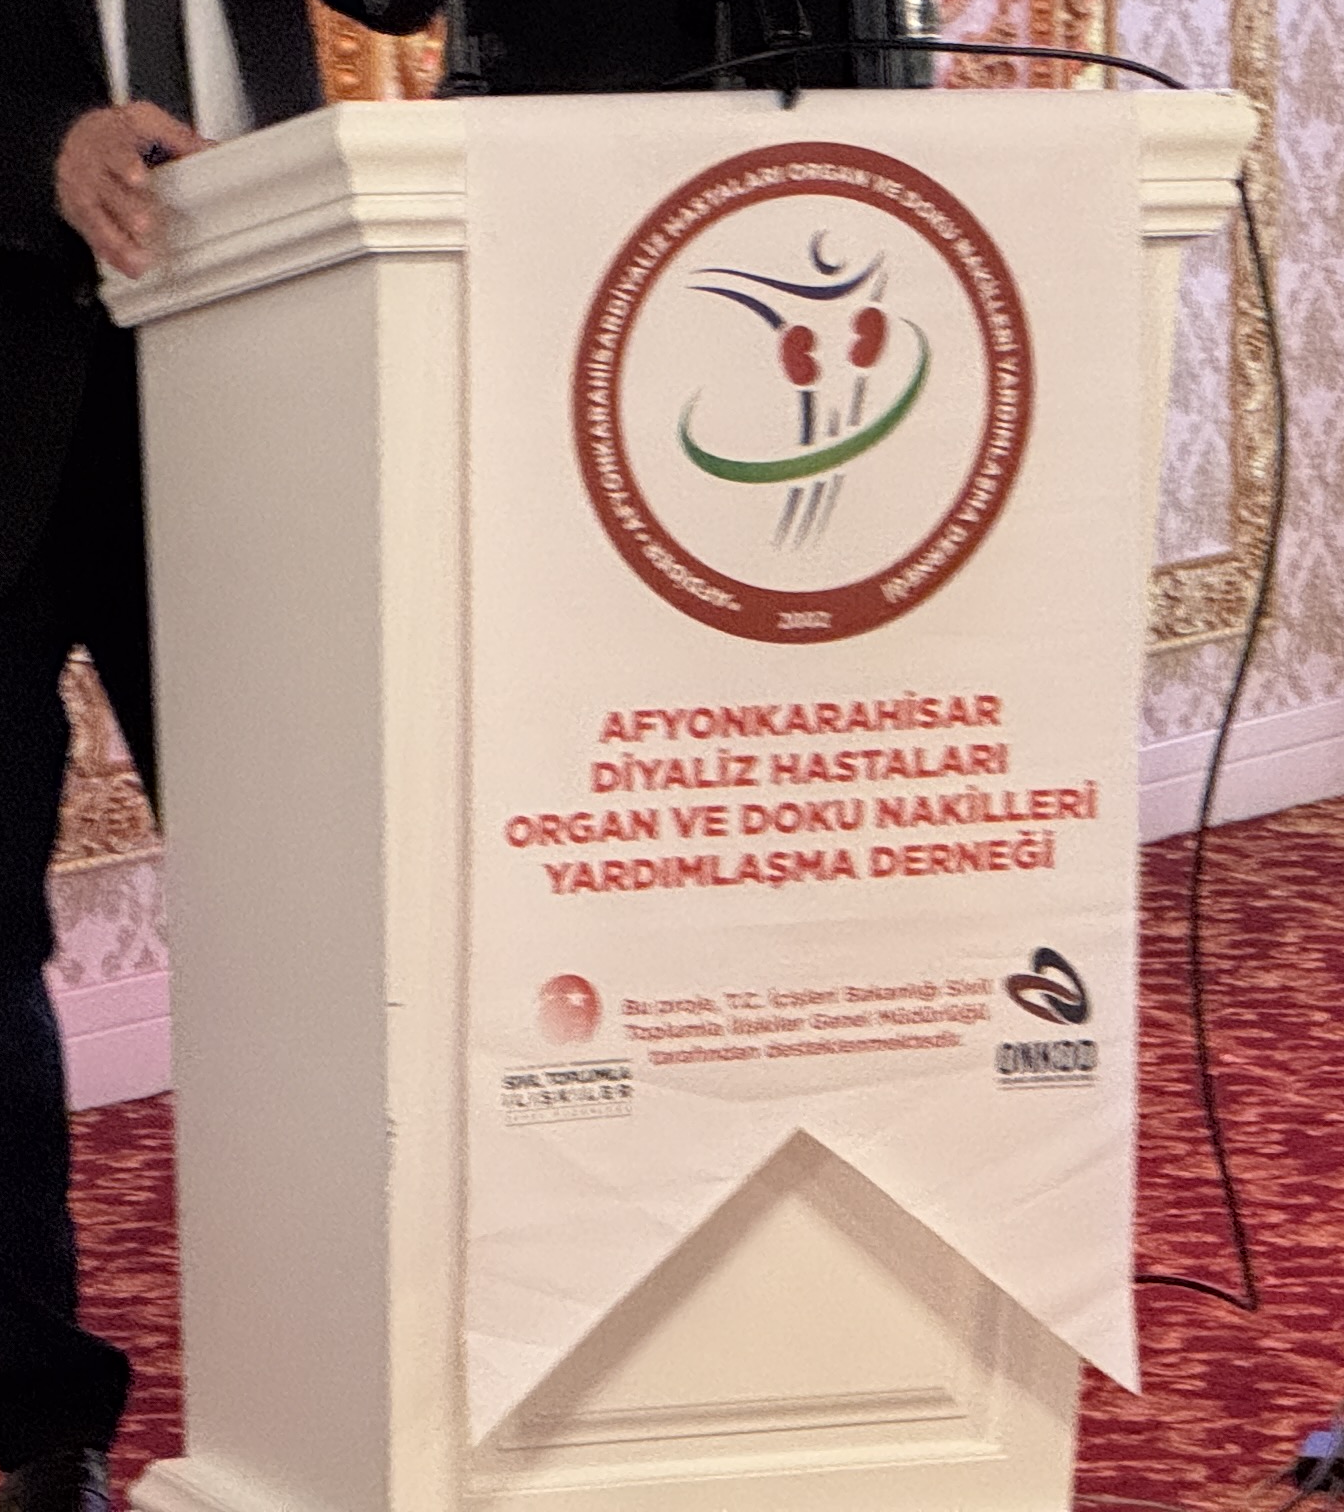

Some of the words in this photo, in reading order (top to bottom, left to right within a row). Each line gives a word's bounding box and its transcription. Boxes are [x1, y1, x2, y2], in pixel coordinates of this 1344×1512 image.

[598, 691, 1004, 745] AFYONKARAHİSAR
[590, 749, 759, 794] DİYALİZ
[769, 743, 1010, 786] HASTALARI
[503, 808, 658, 848] ORGAN
[671, 804, 730, 839] VE
[738, 799, 865, 836] DOKU
[876, 779, 1099, 829] NAKİLLERİ
[542, 848, 856, 895] YARDIMLAŞMA
[868, 829, 1056, 879] DERNEĞİ
